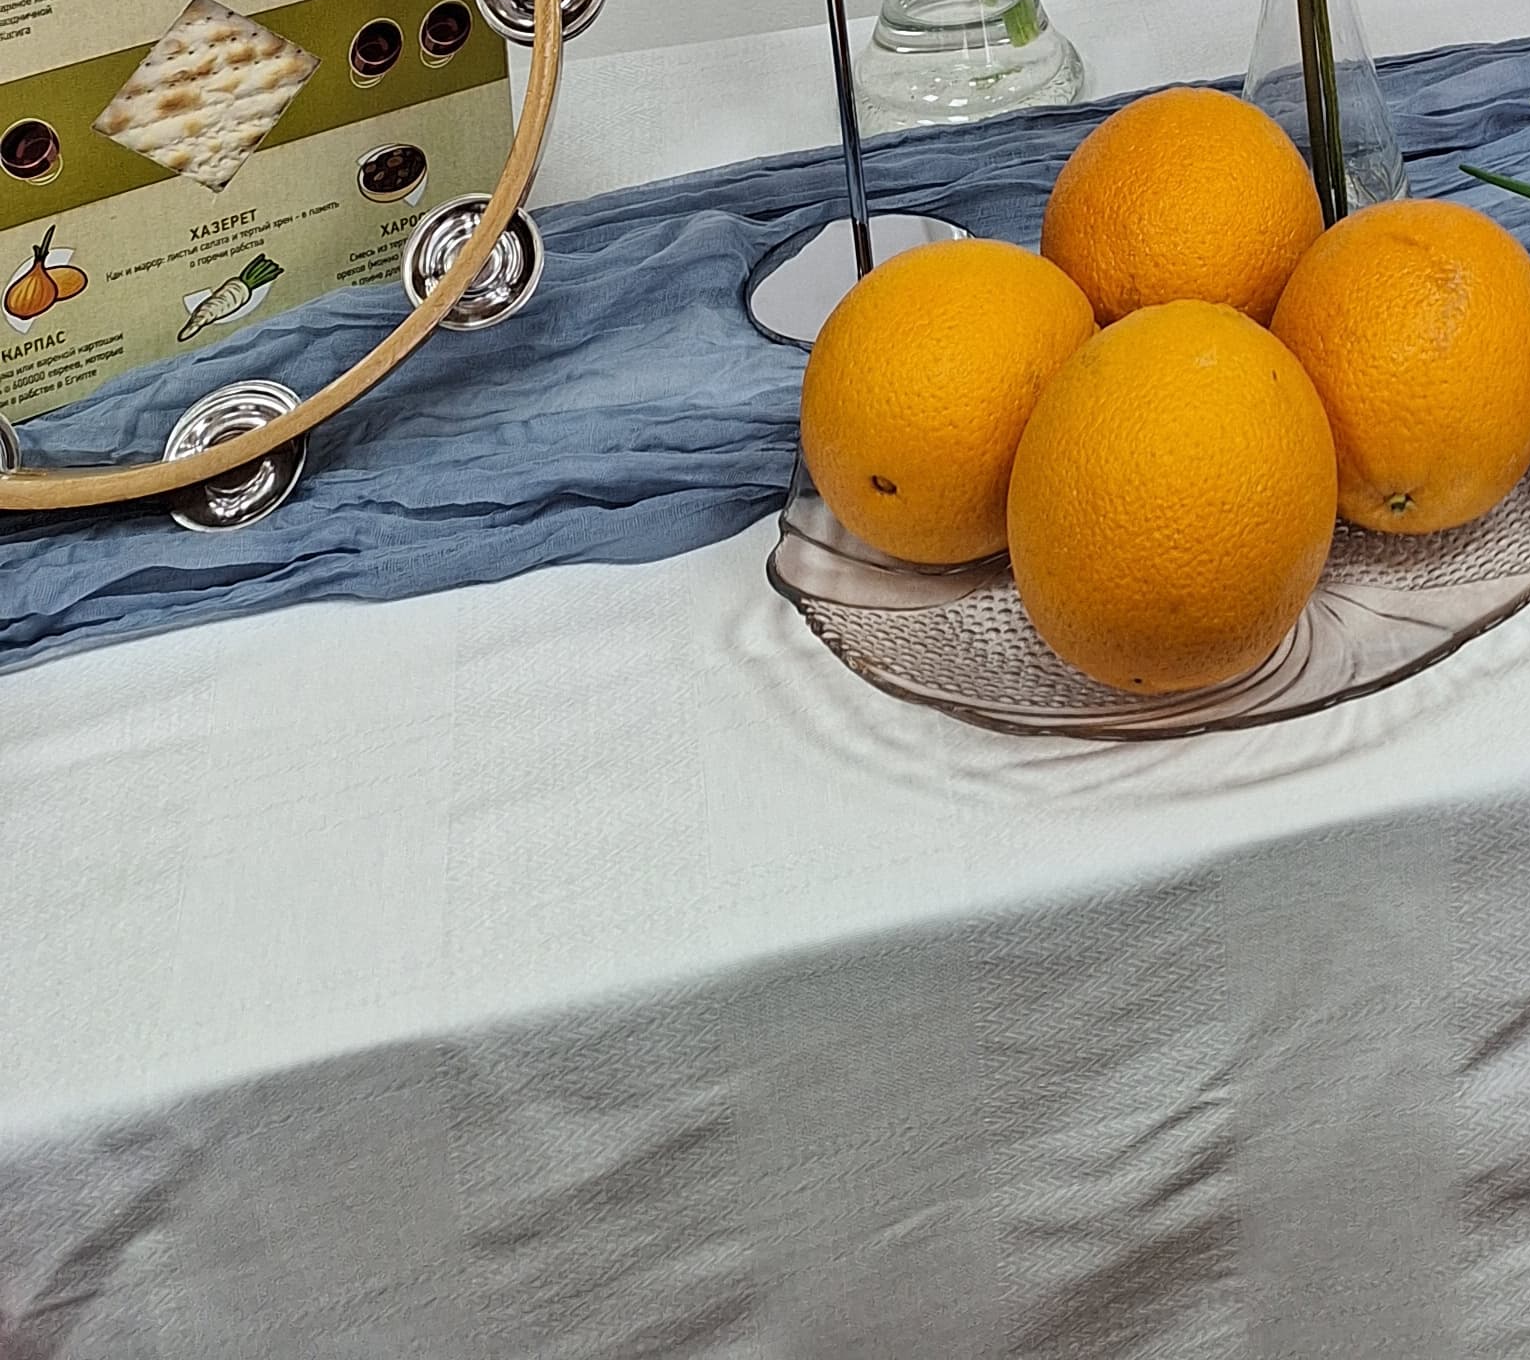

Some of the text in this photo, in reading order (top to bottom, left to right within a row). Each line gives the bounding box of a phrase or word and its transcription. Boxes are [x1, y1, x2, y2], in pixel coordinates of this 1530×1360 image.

[106, 270, 123, 283] Как
[125, 266, 132, 276] и
[134, 256, 166, 273] марор:
[166, 245, 198, 264] листья
[200, 236, 230, 253] салата
[231, 233, 238, 242] и
[239, 221, 271, 239] тертый
[272, 216, 293, 229] хрен
[301, 210, 308, 219] в
[308, 200, 340, 217] память
[190, 208, 257, 241] ХАЗЕРЕТ
[189, 237, 265, 268] о горечи рабства
[1, 331, 66, 363] КАРПАС
[16, 363, 34, 375] или
[37, 347, 76, 368] вареной
[78, 332, 124, 354] картошки
[12, 371, 45, 390] 600000
[85, 347, 124, 365] которые
[18, 383, 55, 404] рабстве
[64, 369, 97, 386] Египте
